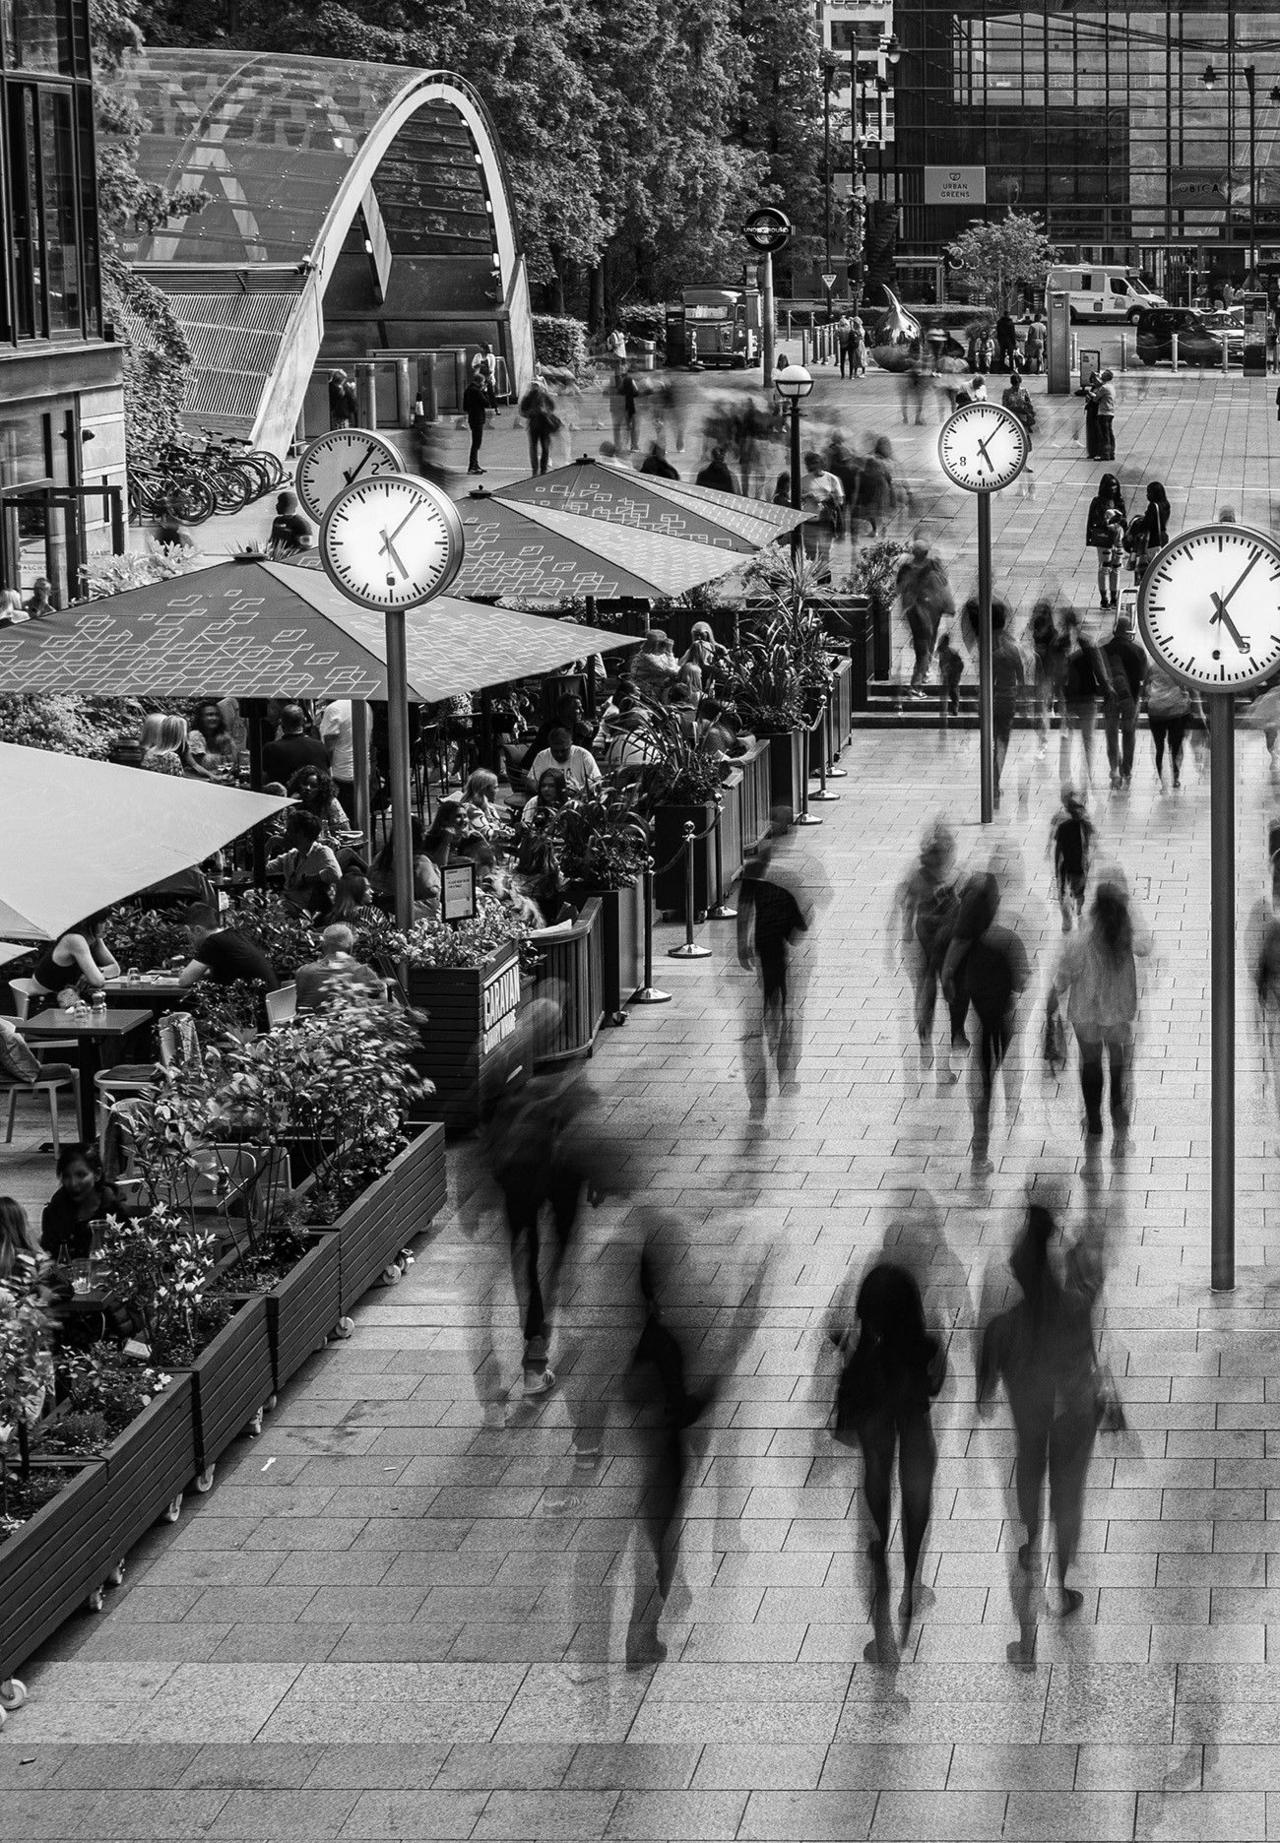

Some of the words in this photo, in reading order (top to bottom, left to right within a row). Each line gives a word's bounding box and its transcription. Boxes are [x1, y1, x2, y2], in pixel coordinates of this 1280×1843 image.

[371, 463, 380, 475] 2
[959, 456, 967, 467] 8
[1239, 635, 1251, 654] 5
[483, 964, 521, 1030] CARAVAN
